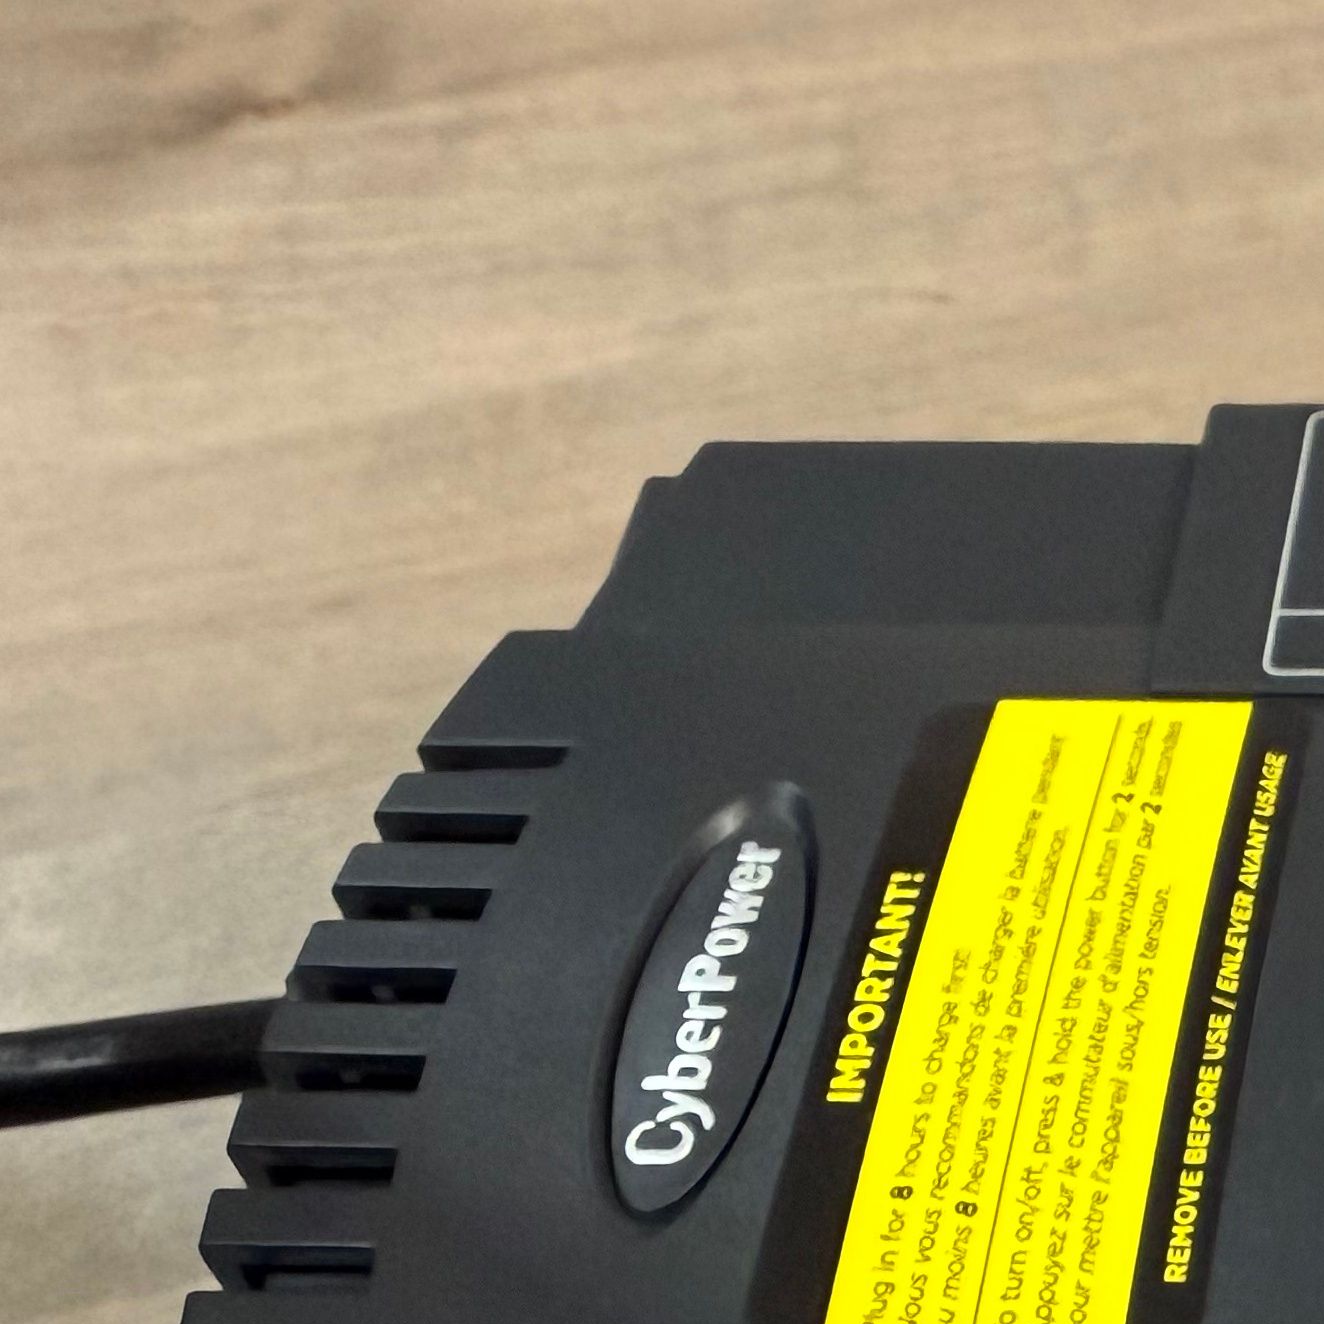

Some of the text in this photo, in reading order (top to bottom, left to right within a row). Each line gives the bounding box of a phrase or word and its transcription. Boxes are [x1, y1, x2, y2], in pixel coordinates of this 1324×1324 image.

[1111, 792, 1135, 803] 2
[1139, 801, 1162, 815] 2
[978, 905, 1014, 984] charger
[1073, 907, 1102, 970] power
[625, 841, 781, 1166] CyberPower
[826, 872, 926, 1103] IMPORTANT!
[969, 988, 993, 1017] de
[1060, 975, 1087, 1009] the
[922, 1000, 959, 1075] charge
[1046, 1016, 1077, 1064] hold
[1163, 751, 1287, 1282] REMOVE BEFORE USE / ENLEVER AVANT USAGE
[912, 1081, 938, 1105] to
[982, 1047, 1012, 1110] avant
[1042, 1071, 1065, 1087] &
[1067, 998, 1113, 1148] commutateur
[894, 1111, 931, 1177] hours
[1032, 1094, 1060, 1154] press
[1078, 1190, 1109, 1275] mettre
[1116, 966, 1154, 1072] sous/hors
[960, 1115, 996, 1195] heures
[1056, 1154, 1081, 1177] le
[889, 1185, 913, 1200] 8
[954, 1200, 978, 1217] 8
[1052, 1181, 1074, 1222] sur
[871, 1250, 899, 1272] in
[914, 1207, 942, 1263] vous
[941, 1224, 973, 1301] moins
[999, 1249, 1027, 1301] turn
